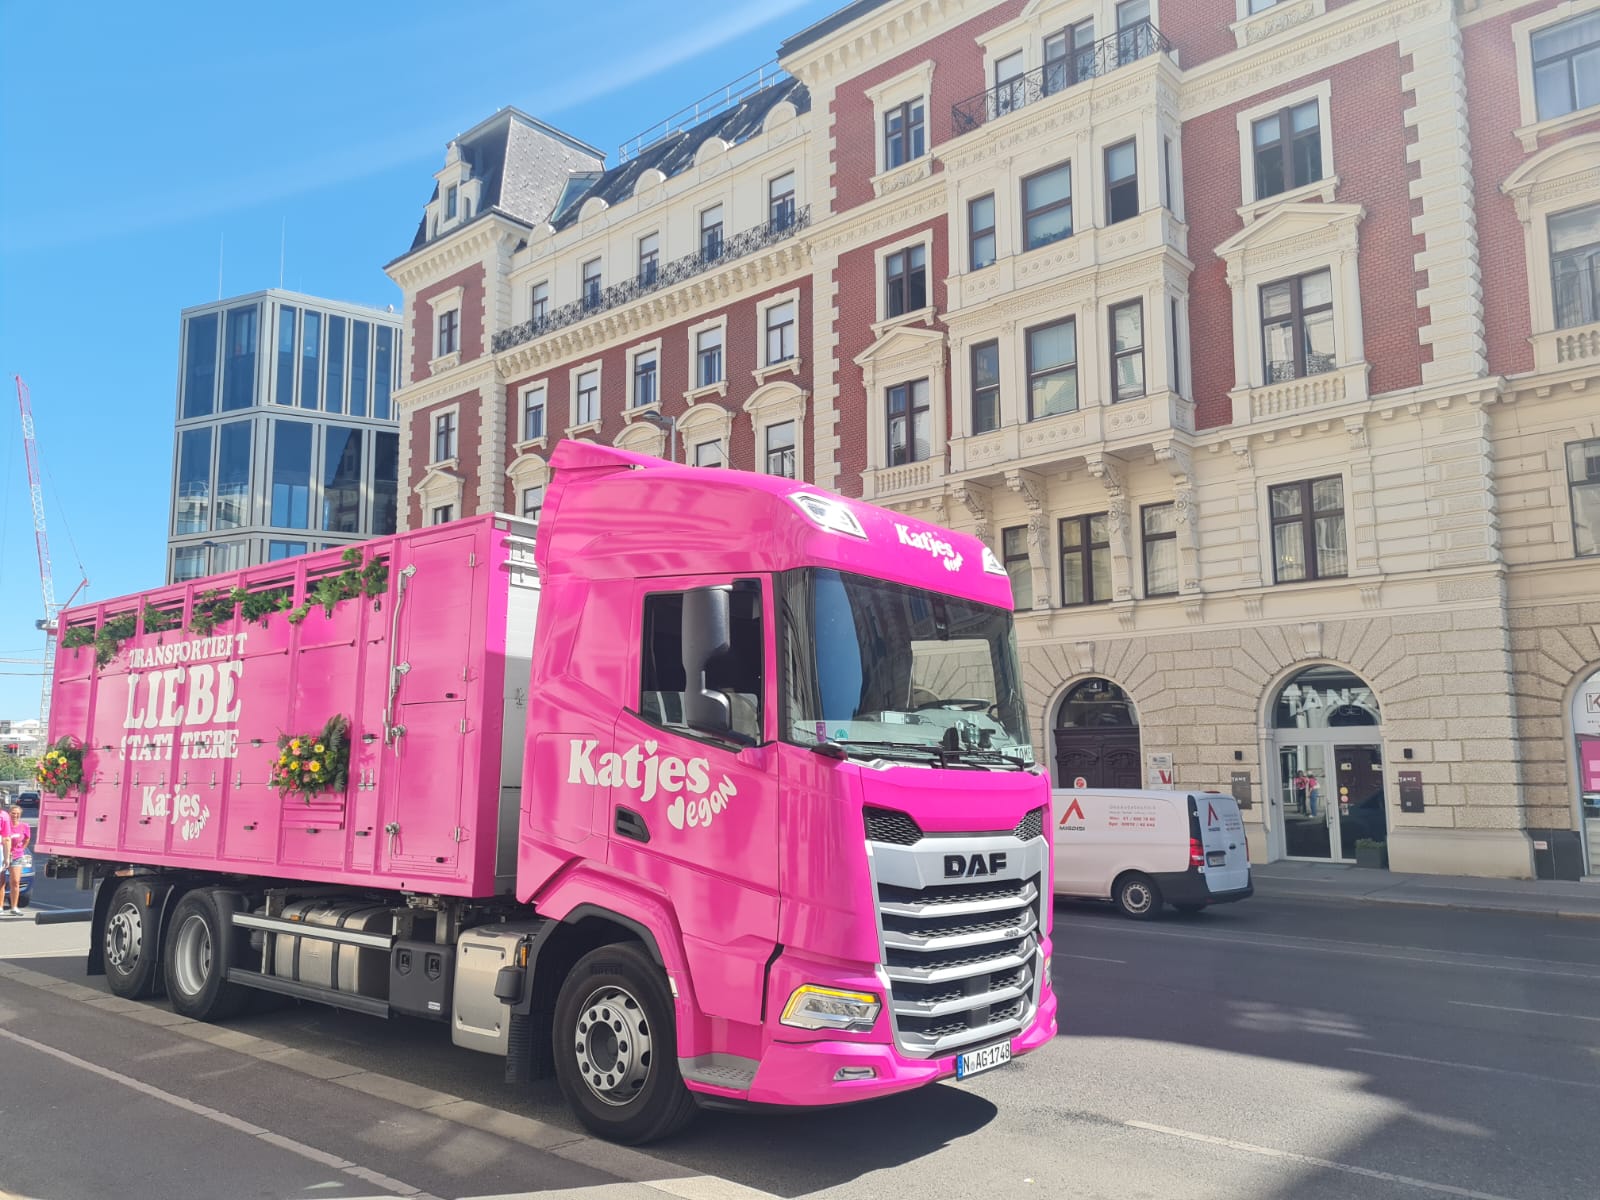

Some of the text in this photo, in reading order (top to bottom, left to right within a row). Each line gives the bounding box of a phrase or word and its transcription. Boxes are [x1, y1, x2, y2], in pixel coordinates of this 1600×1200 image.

[894, 523, 955, 558] Katjes
[123, 660, 243, 729] LIEBE
[1282, 683, 1373, 717] TANZ
[119, 729, 239, 761] STATT TIERE
[567, 740, 710, 802] Katjes
[944, 852, 1007, 878] DAF
[963, 1055, 970, 1074] N
